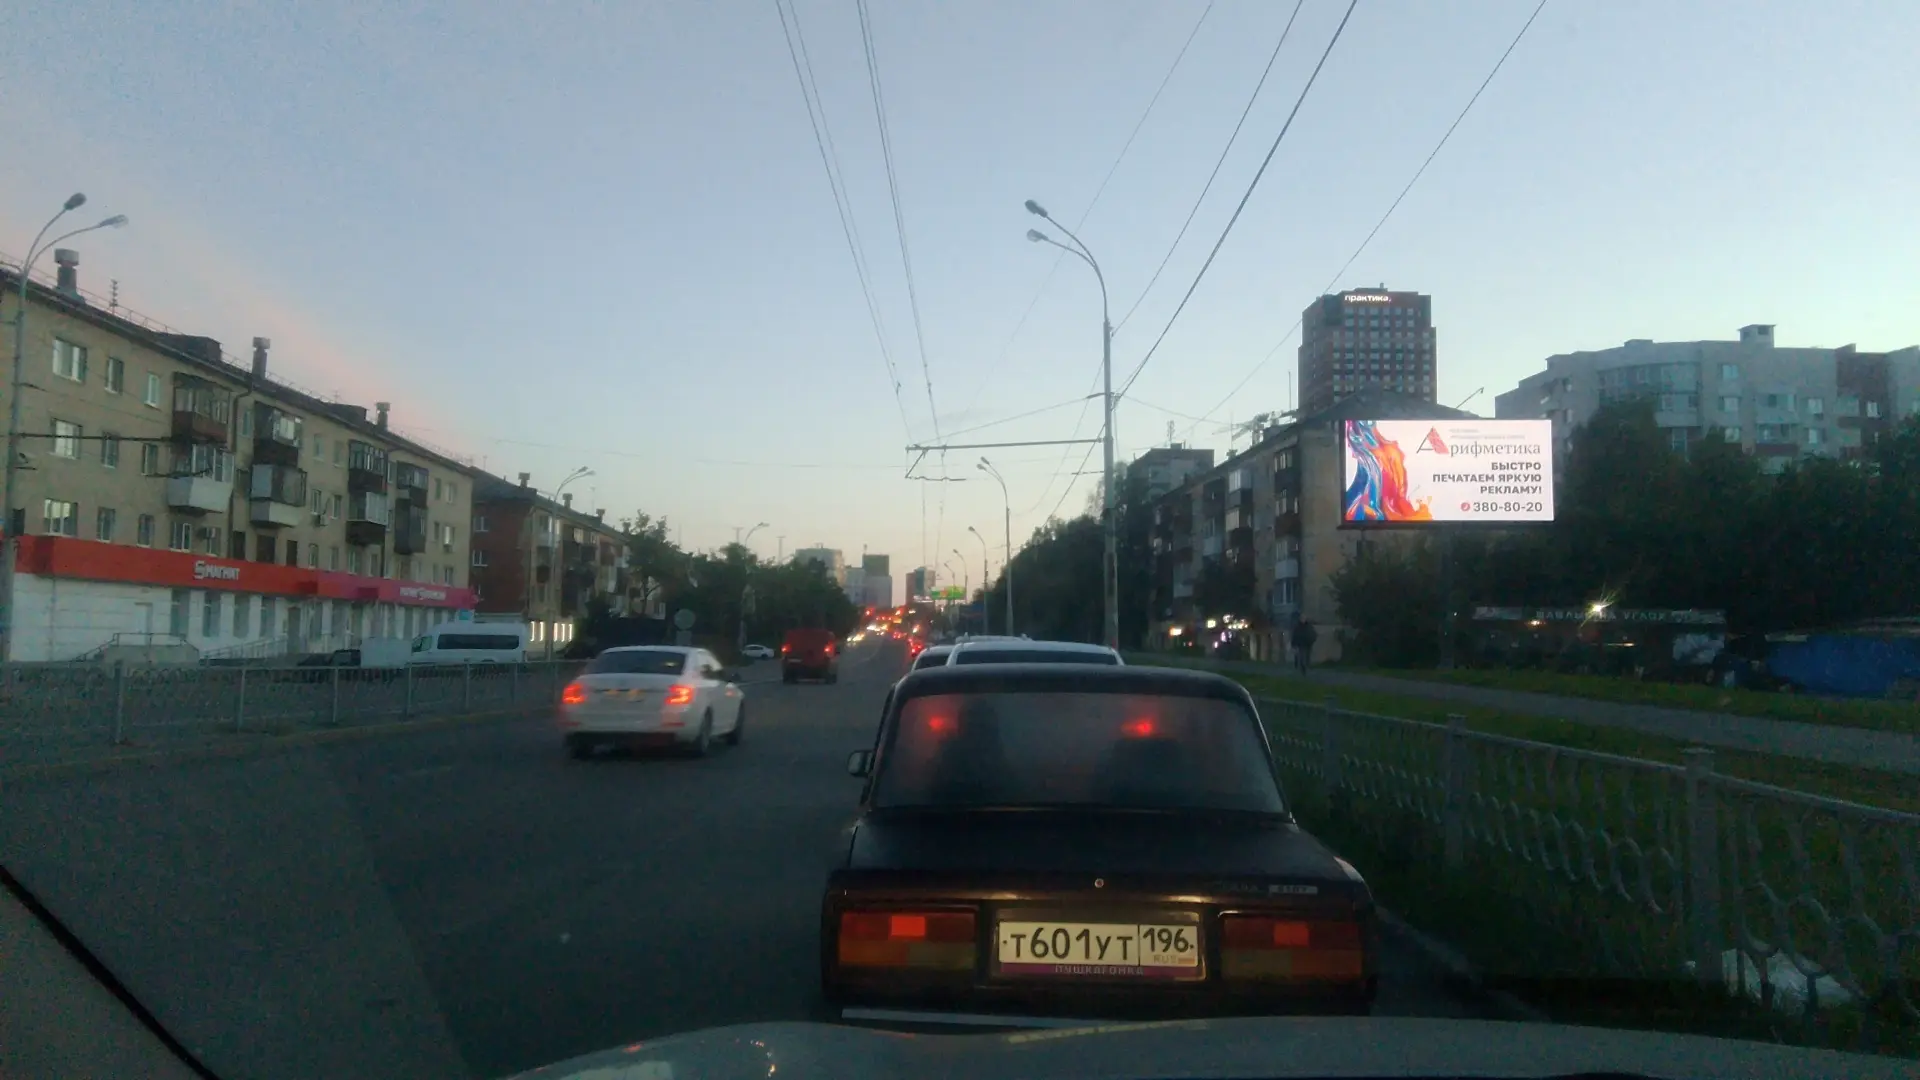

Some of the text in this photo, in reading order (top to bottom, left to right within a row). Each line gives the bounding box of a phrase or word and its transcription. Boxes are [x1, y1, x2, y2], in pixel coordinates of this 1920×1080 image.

[1416, 426, 1541, 457] Арифметика
[1491, 462, 1542, 471] БЫСТРО
[1432, 473, 1542, 483] ПЕЧАТАЕМ ЯРКУЮ
[1480, 485, 1542, 495] РЕКЛАМУ!
[1473, 501, 1543, 512] 380-80-20
[1010, 927, 1133, 960] Т601УТ
[1142, 928, 1189, 953] 196
